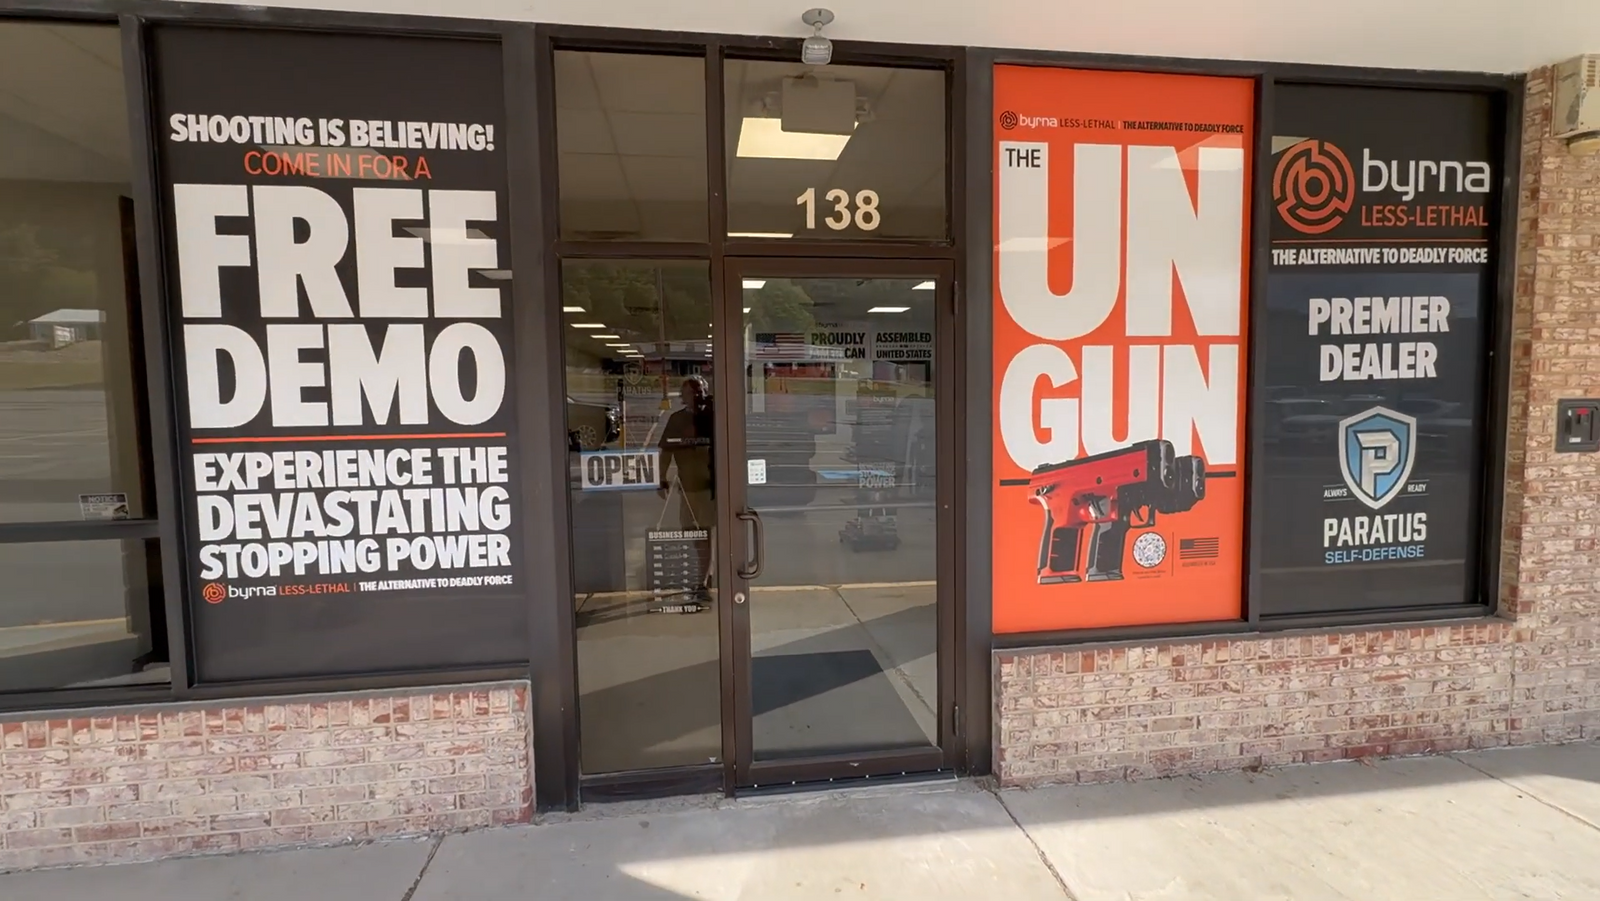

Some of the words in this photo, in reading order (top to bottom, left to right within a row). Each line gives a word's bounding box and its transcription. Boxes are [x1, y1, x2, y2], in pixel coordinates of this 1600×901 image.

[170, 113, 314, 146] SHOOTING
[319, 118, 346, 147] IS
[349, 119, 494, 151] BELIEVING!
[1020, 113, 1058, 129] byrna
[1059, 118, 1116, 130] LESS-LETHAL
[1123, 120, 1137, 131] THE
[1137, 121, 1184, 132] ALTERNATIVE
[1184, 122, 1194, 132] TO
[1193, 123, 1221, 133] DEADLY
[1221, 124, 1244, 133] FORCE
[243, 151, 320, 177] COME
[326, 153, 351, 178] IN
[358, 155, 410, 181] FOR
[413, 156, 432, 180] A
[1005, 148, 1041, 168] THE
[1362, 148, 1491, 202] byrna
[795, 187, 881, 231] 138
[1361, 205, 1489, 227] LESS-LETHAL
[173, 183, 502, 319] FREE
[998, 141, 1244, 341] UN
[1272, 249, 1297, 266] THE
[1297, 248, 1381, 265] ALTERNATIVE
[1382, 248, 1400, 264] TO
[1399, 247, 1449, 265] DEADLY
[1448, 247, 1488, 264] FORCE
[1308, 296, 1450, 336] PREMIER
[811, 332, 866, 345] PROUDLY
[875, 332, 932, 343] ASSEMBLED
[876, 349, 905, 358] UNITED
[905, 349, 932, 358] STATES
[183, 322, 506, 429] DEMO
[1320, 342, 1438, 382] DEALER
[999, 343, 1240, 473] GUN
[192, 447, 433, 491] EXPERIENCE
[437, 446, 508, 484] THE
[587, 454, 654, 486] OPEN
[1323, 488, 1348, 498] ALWAYS
[1407, 484, 1426, 493] READY
[196, 486, 511, 541] DEVASTATING
[648, 531, 683, 539] BUSINESS
[683, 530, 708, 538] HOURS
[1324, 512, 1427, 548] PARATUS
[199, 538, 381, 580] STOPPING
[387, 534, 511, 572] POWER
[1325, 545, 1425, 564] SELF-DEFENSE
[228, 585, 277, 600] byrna
[279, 582, 349, 596] LESS-LETHAL
[358, 581, 378, 592] THE
[377, 578, 436, 592] ALTERNATIVE
[436, 578, 449, 589] TO
[448, 576, 484, 589] DEADLY
[483, 575, 513, 587] FORCE
[662, 605, 683, 613] THANK
[684, 605, 697, 613] YOU
